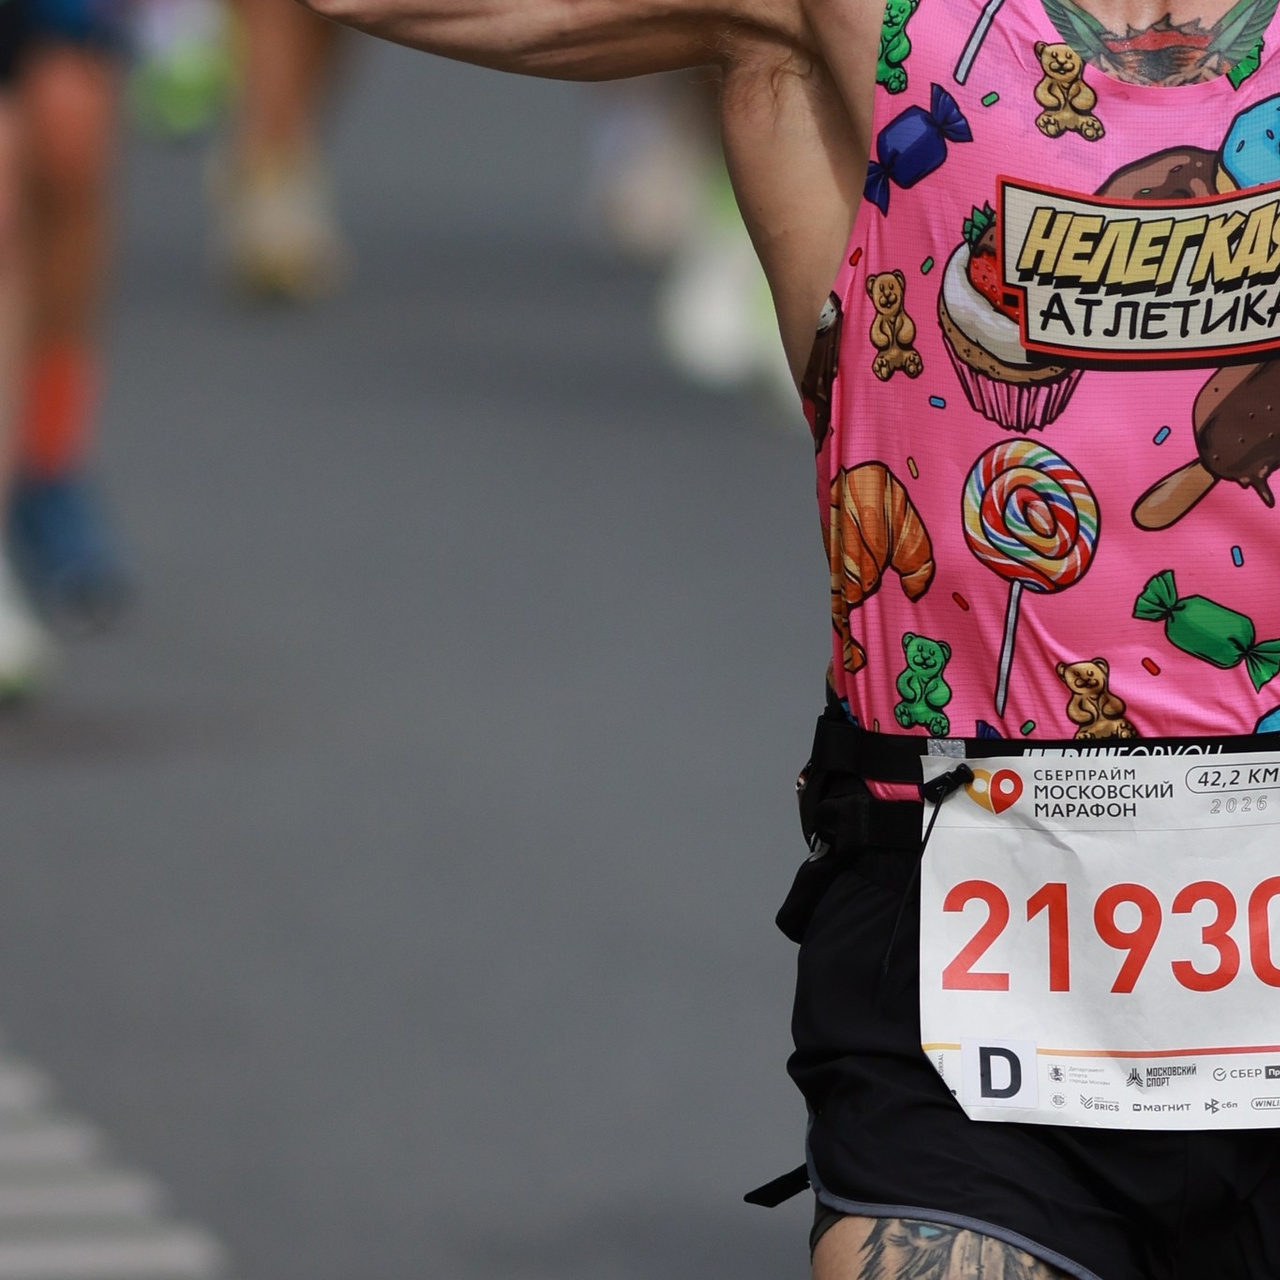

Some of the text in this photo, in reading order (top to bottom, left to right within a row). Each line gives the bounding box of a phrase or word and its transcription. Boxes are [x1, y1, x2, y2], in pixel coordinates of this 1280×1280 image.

[1033, 766, 1136, 781] СБЕРПРАЙМ
[1197, 769, 1241, 788] 42,2
[1033, 781, 1174, 800] МОСКОВСКИЙ
[1034, 802, 1137, 818] МАРАФОН
[1210, 795, 1268, 814] 2026
[979, 1046, 1022, 1099] D
[1146, 1063, 1197, 1077] МОСКОВСКИЙ
[1230, 1069, 1262, 1078] СБЕР
[1146, 1077, 1170, 1087] СПОРТ
[1094, 1103, 1119, 1112] BRICS
